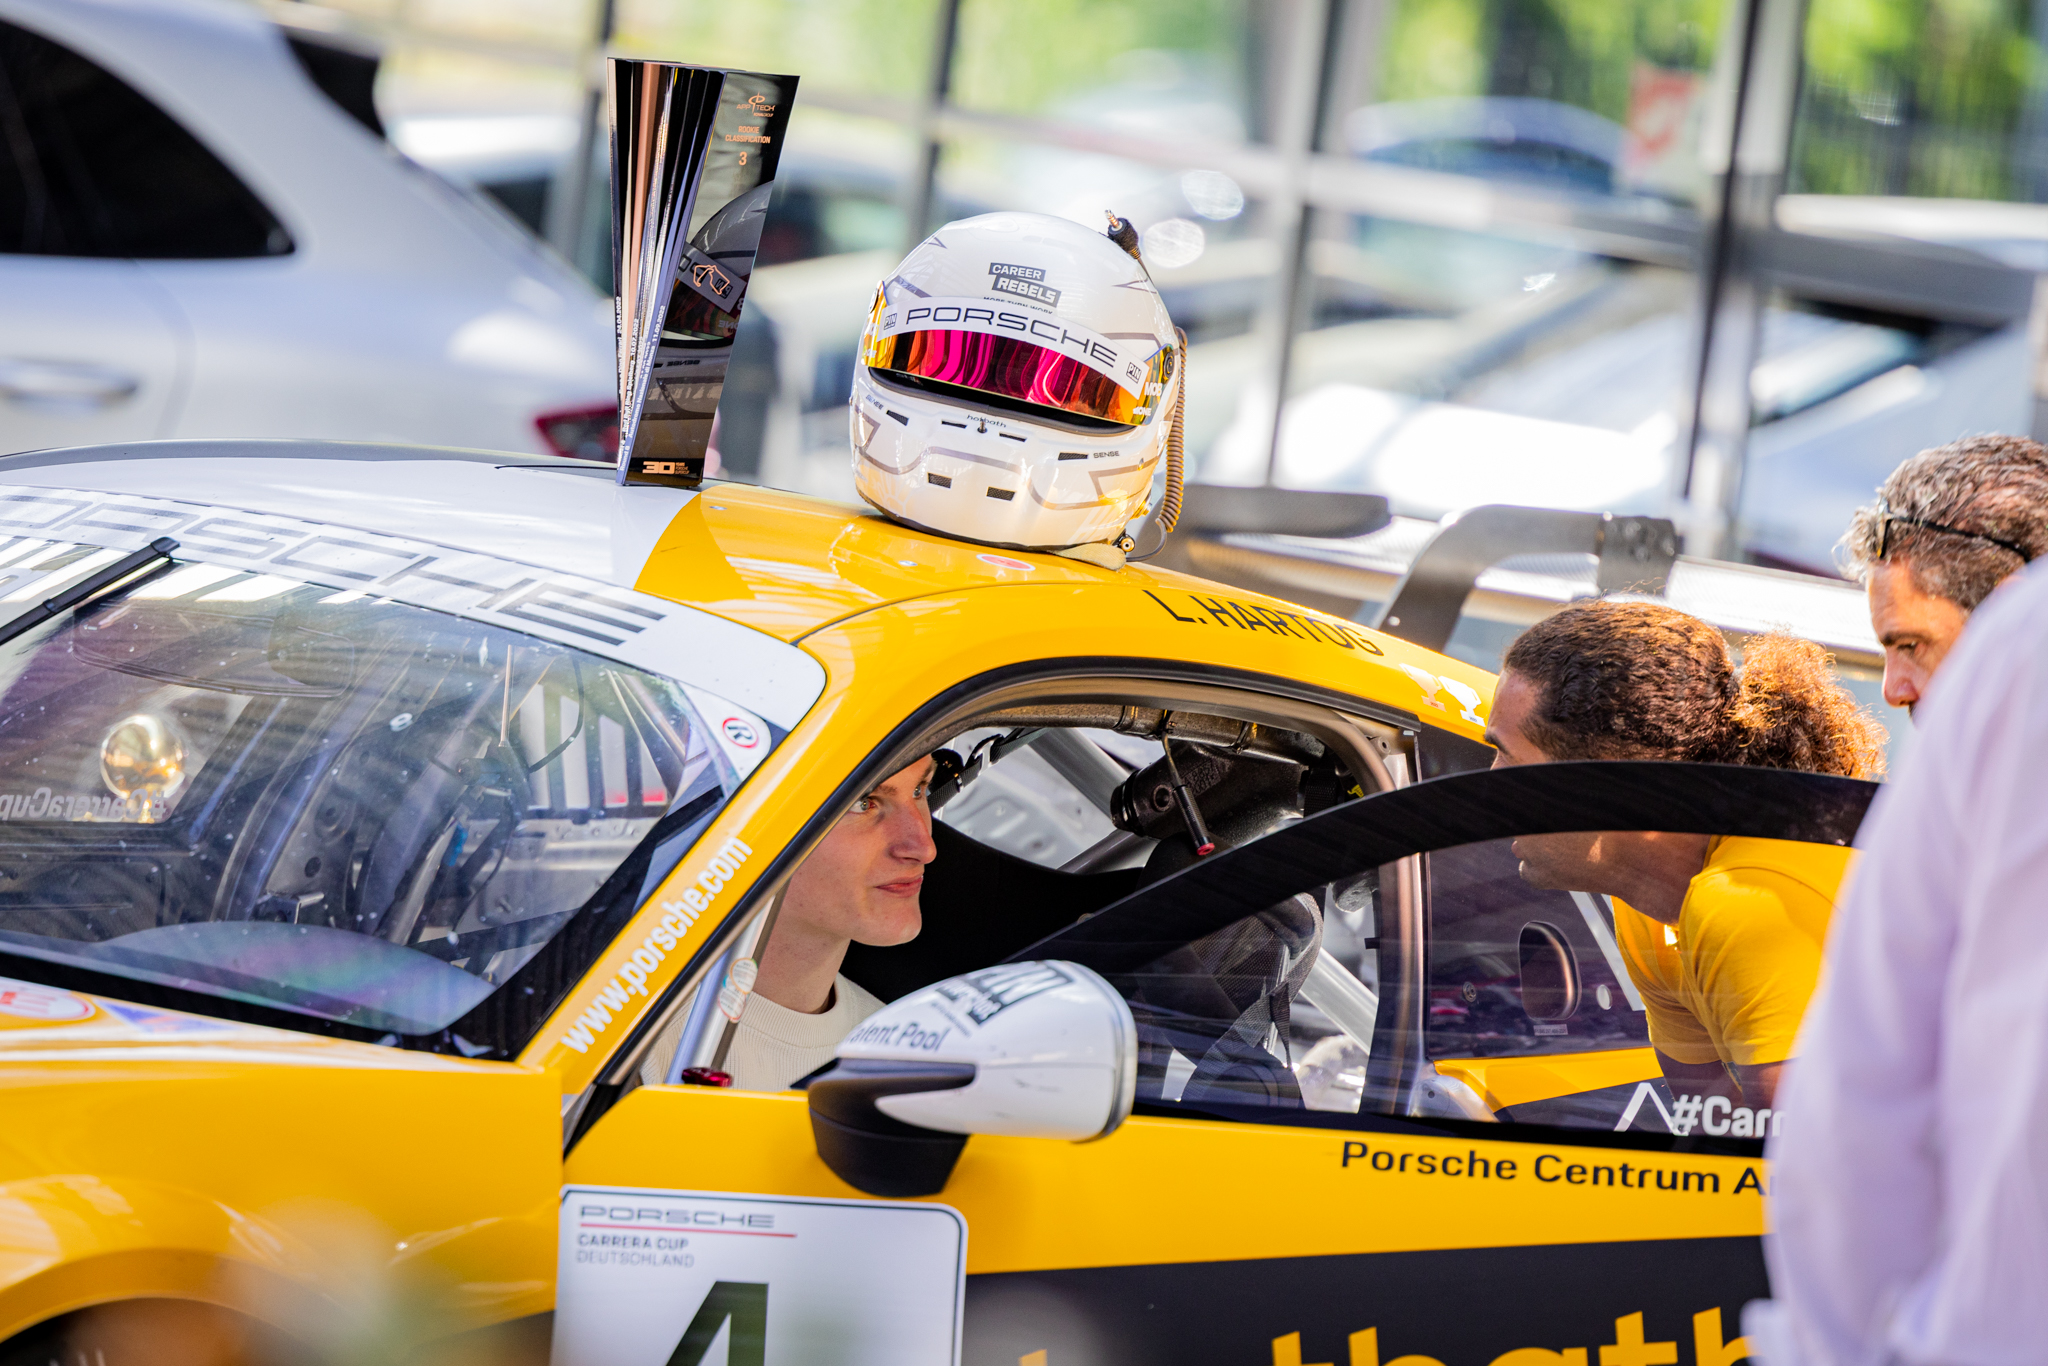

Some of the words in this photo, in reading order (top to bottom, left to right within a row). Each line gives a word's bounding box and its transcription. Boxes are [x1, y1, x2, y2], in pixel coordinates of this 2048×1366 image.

[756, 104, 776, 112] TECH
[725, 134, 771, 144] CLASSIFICATION
[738, 125, 760, 134] ROOKIE
[738, 151, 748, 166] 3
[992, 264, 1042, 280] CAREER
[996, 277, 1057, 304] REBELS
[652, 305, 666, 343] 11.09.2022
[630, 318, 639, 356] 10.07.2022
[905, 306, 1118, 370] PORSCHE
[646, 345, 656, 366] Monza
[645, 364, 651, 374] di
[1128, 364, 1142, 380] PIN
[636, 373, 649, 403] Nazionale
[1144, 382, 1163, 396] MOB
[629, 403, 641, 438] Autodromo
[620, 451, 629, 472] Round
[1093, 450, 1120, 459] SENSE
[560, 836, 753, 1055] www.porsche.com
[896, 1022, 951, 1051] Pool
[1340, 1140, 1518, 1182] Porsche
[1533, 1154, 1721, 1194] Centrum
[1732, 1166, 1776, 1197] A
[580, 1205, 775, 1228] PORSCHE
[577, 1233, 652, 1250] CARRERA
[656, 1237, 690, 1250] CUP
[576, 1250, 695, 1268] DEUTSCHLAND
